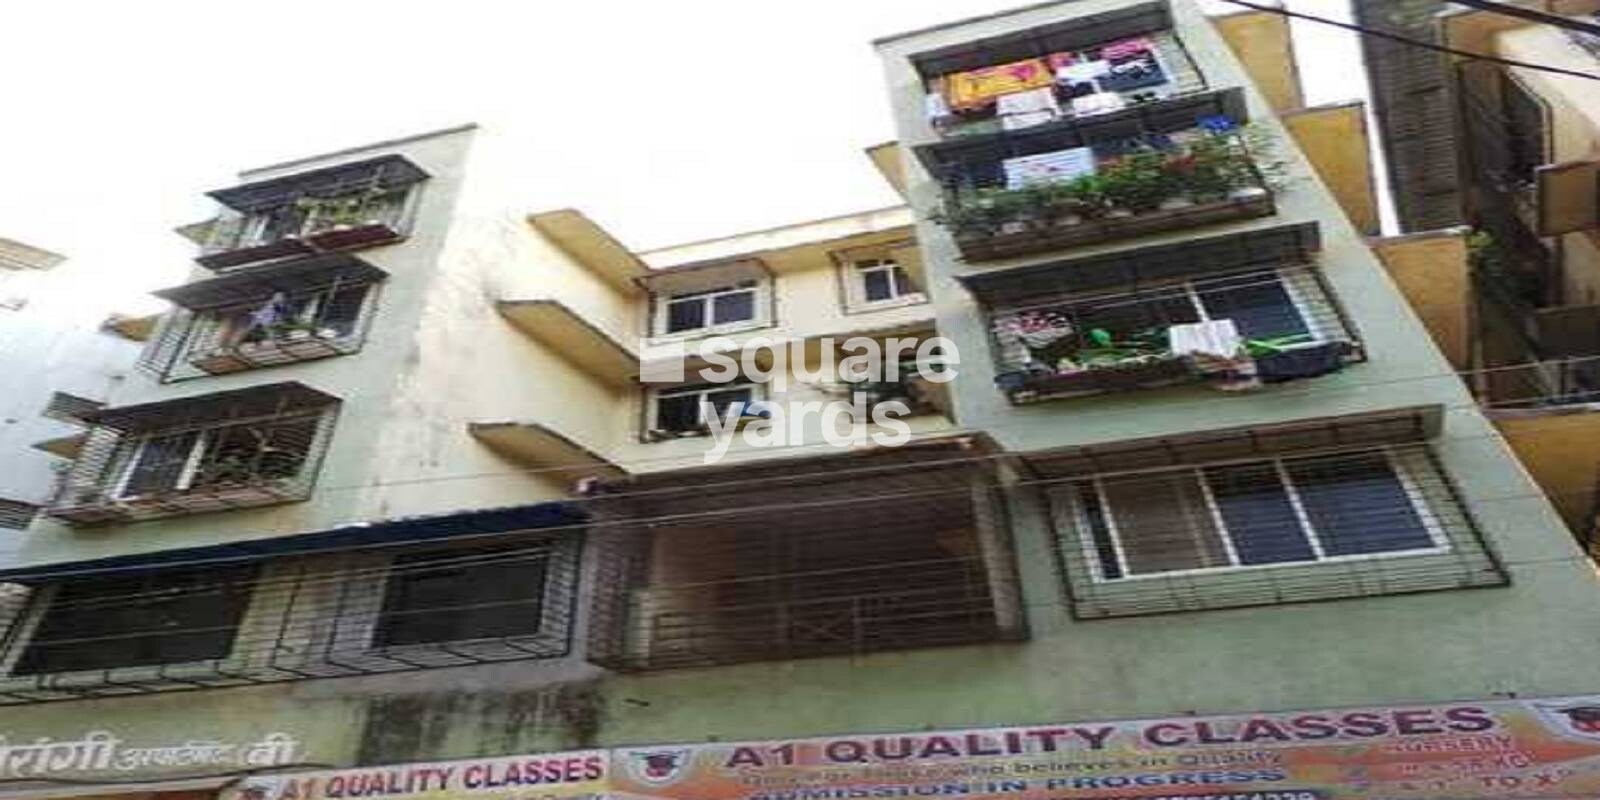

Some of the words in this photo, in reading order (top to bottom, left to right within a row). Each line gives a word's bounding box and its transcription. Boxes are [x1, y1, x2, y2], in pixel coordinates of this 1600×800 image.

[727, 744, 794, 767] A1
[826, 727, 1115, 763] QUALITY
[1143, 707, 1494, 746] CLASSES
[325, 768, 454, 798] QUALITY
[464, 757, 603, 788] CLASSES
[988, 781, 1026, 793] IN
[1048, 772, 1286, 789] PROGRESS
